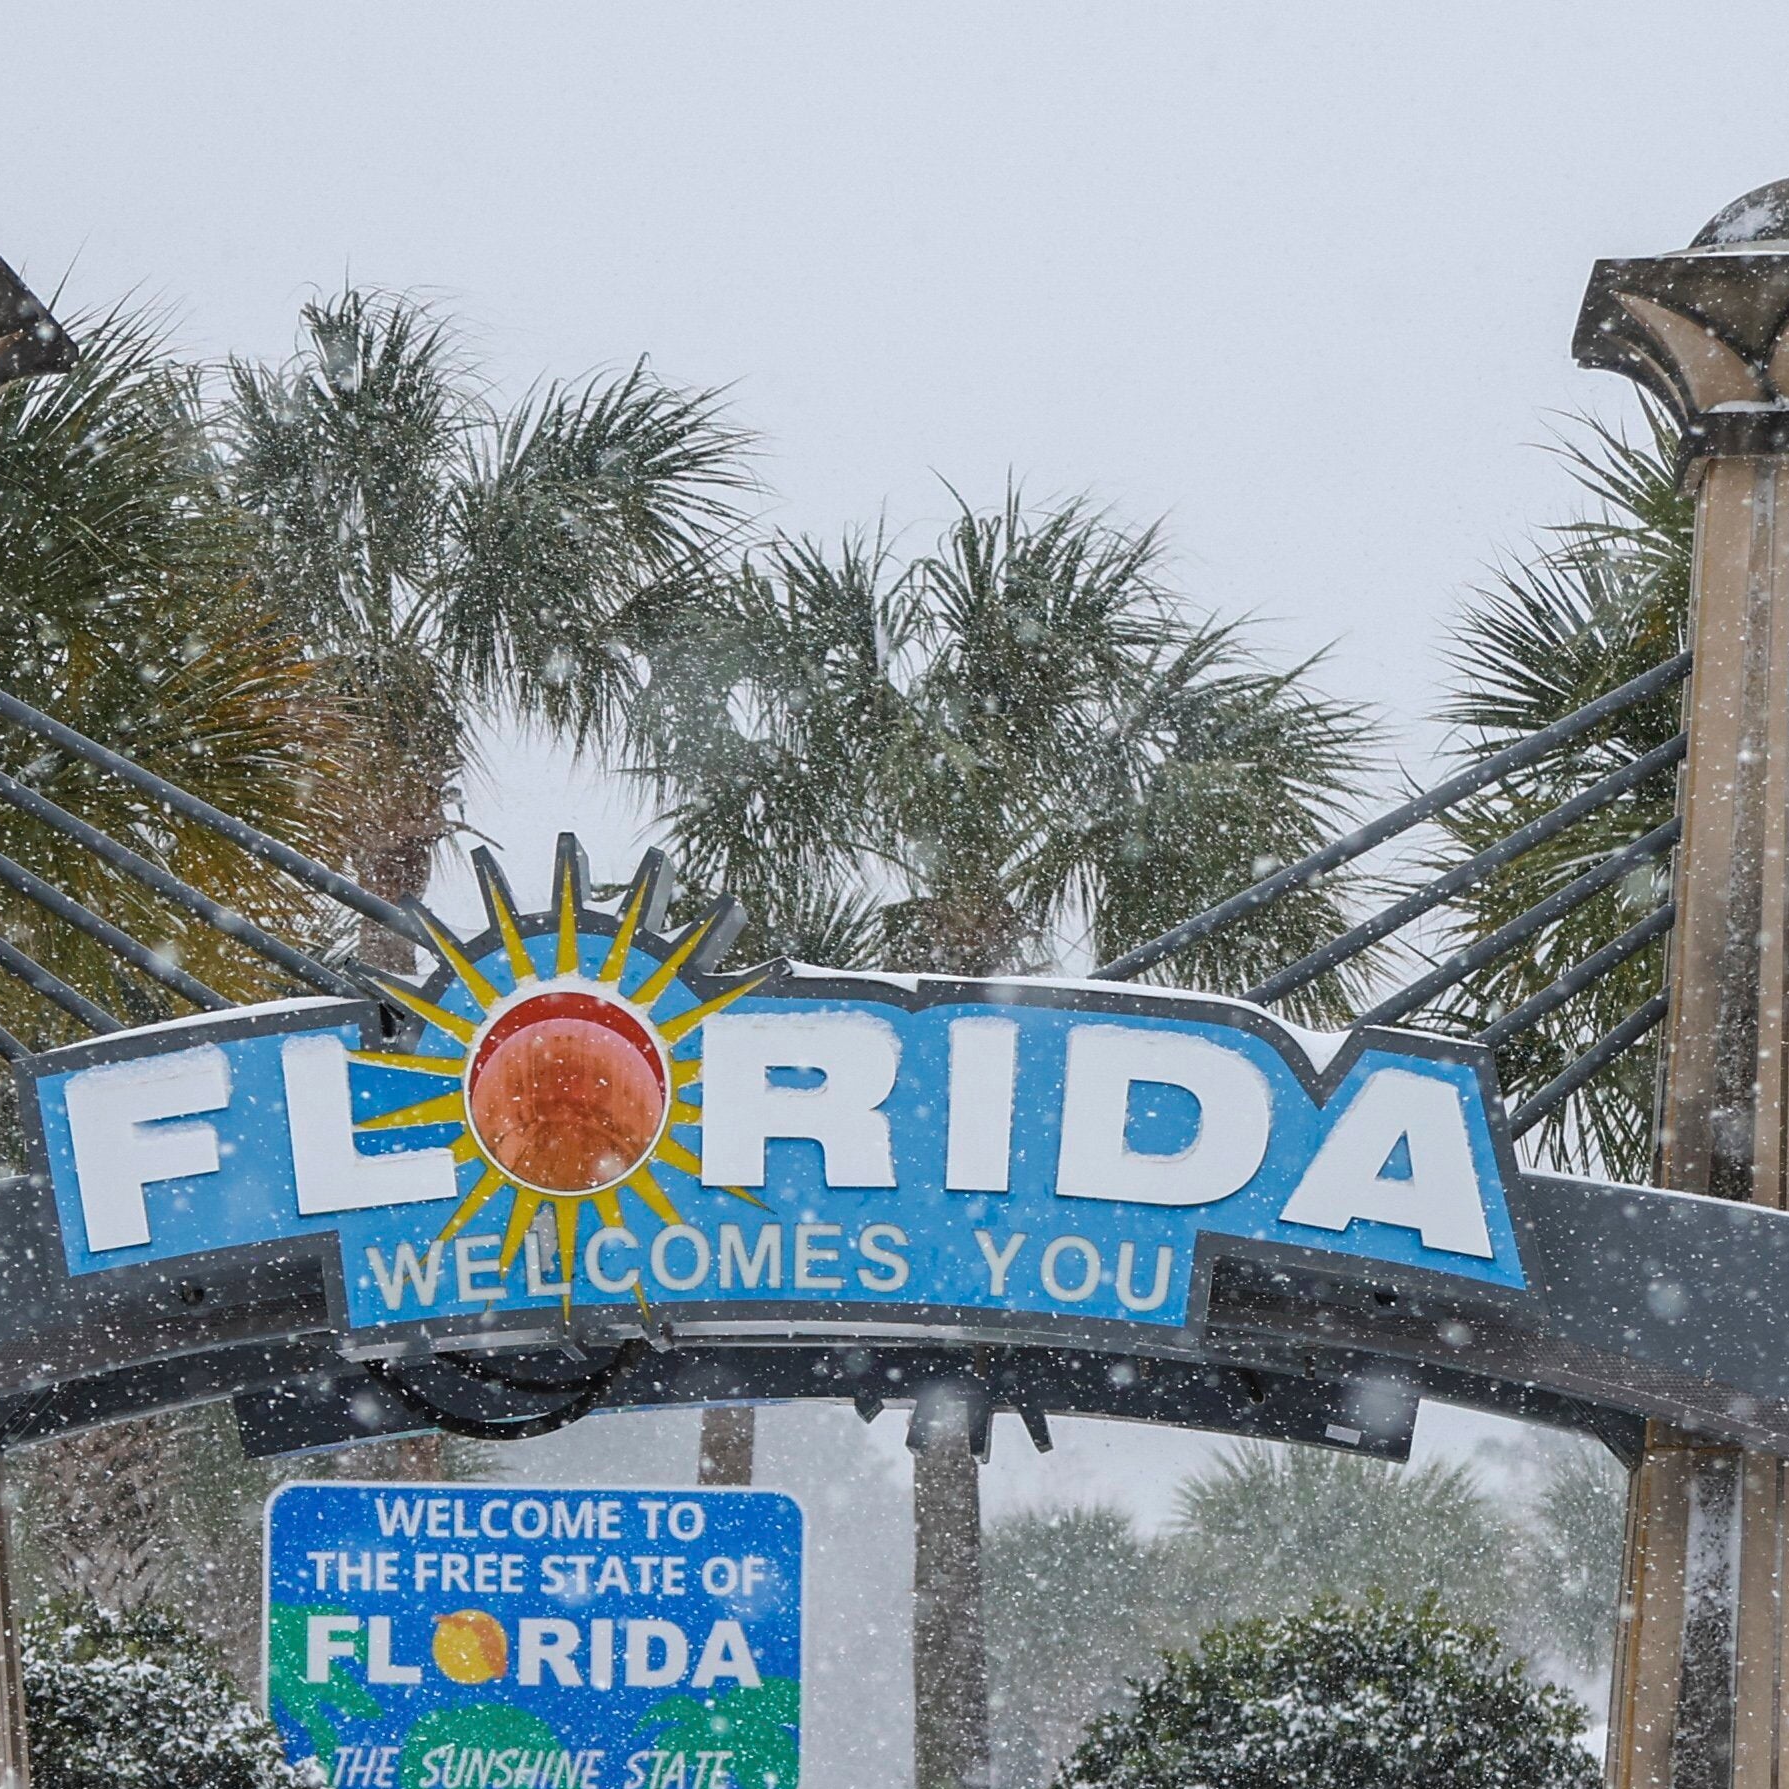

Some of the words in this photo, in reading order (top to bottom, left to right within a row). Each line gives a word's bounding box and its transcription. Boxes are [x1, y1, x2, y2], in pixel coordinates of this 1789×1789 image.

[63, 988, 1494, 1260] FLORIDA
[364, 1223, 911, 1312] WELCOMES
[973, 1229, 1175, 1312] YOU
[374, 1498, 622, 1541] WELCOME
[637, 1500, 706, 1542] TO
[306, 1551, 399, 1592] THE
[414, 1553, 524, 1593] FREE
[539, 1555, 686, 1595] STATE
[701, 1556, 766, 1597] OF
[306, 1609, 764, 1689] FLORIDA
[333, 1746, 400, 1789] THE
